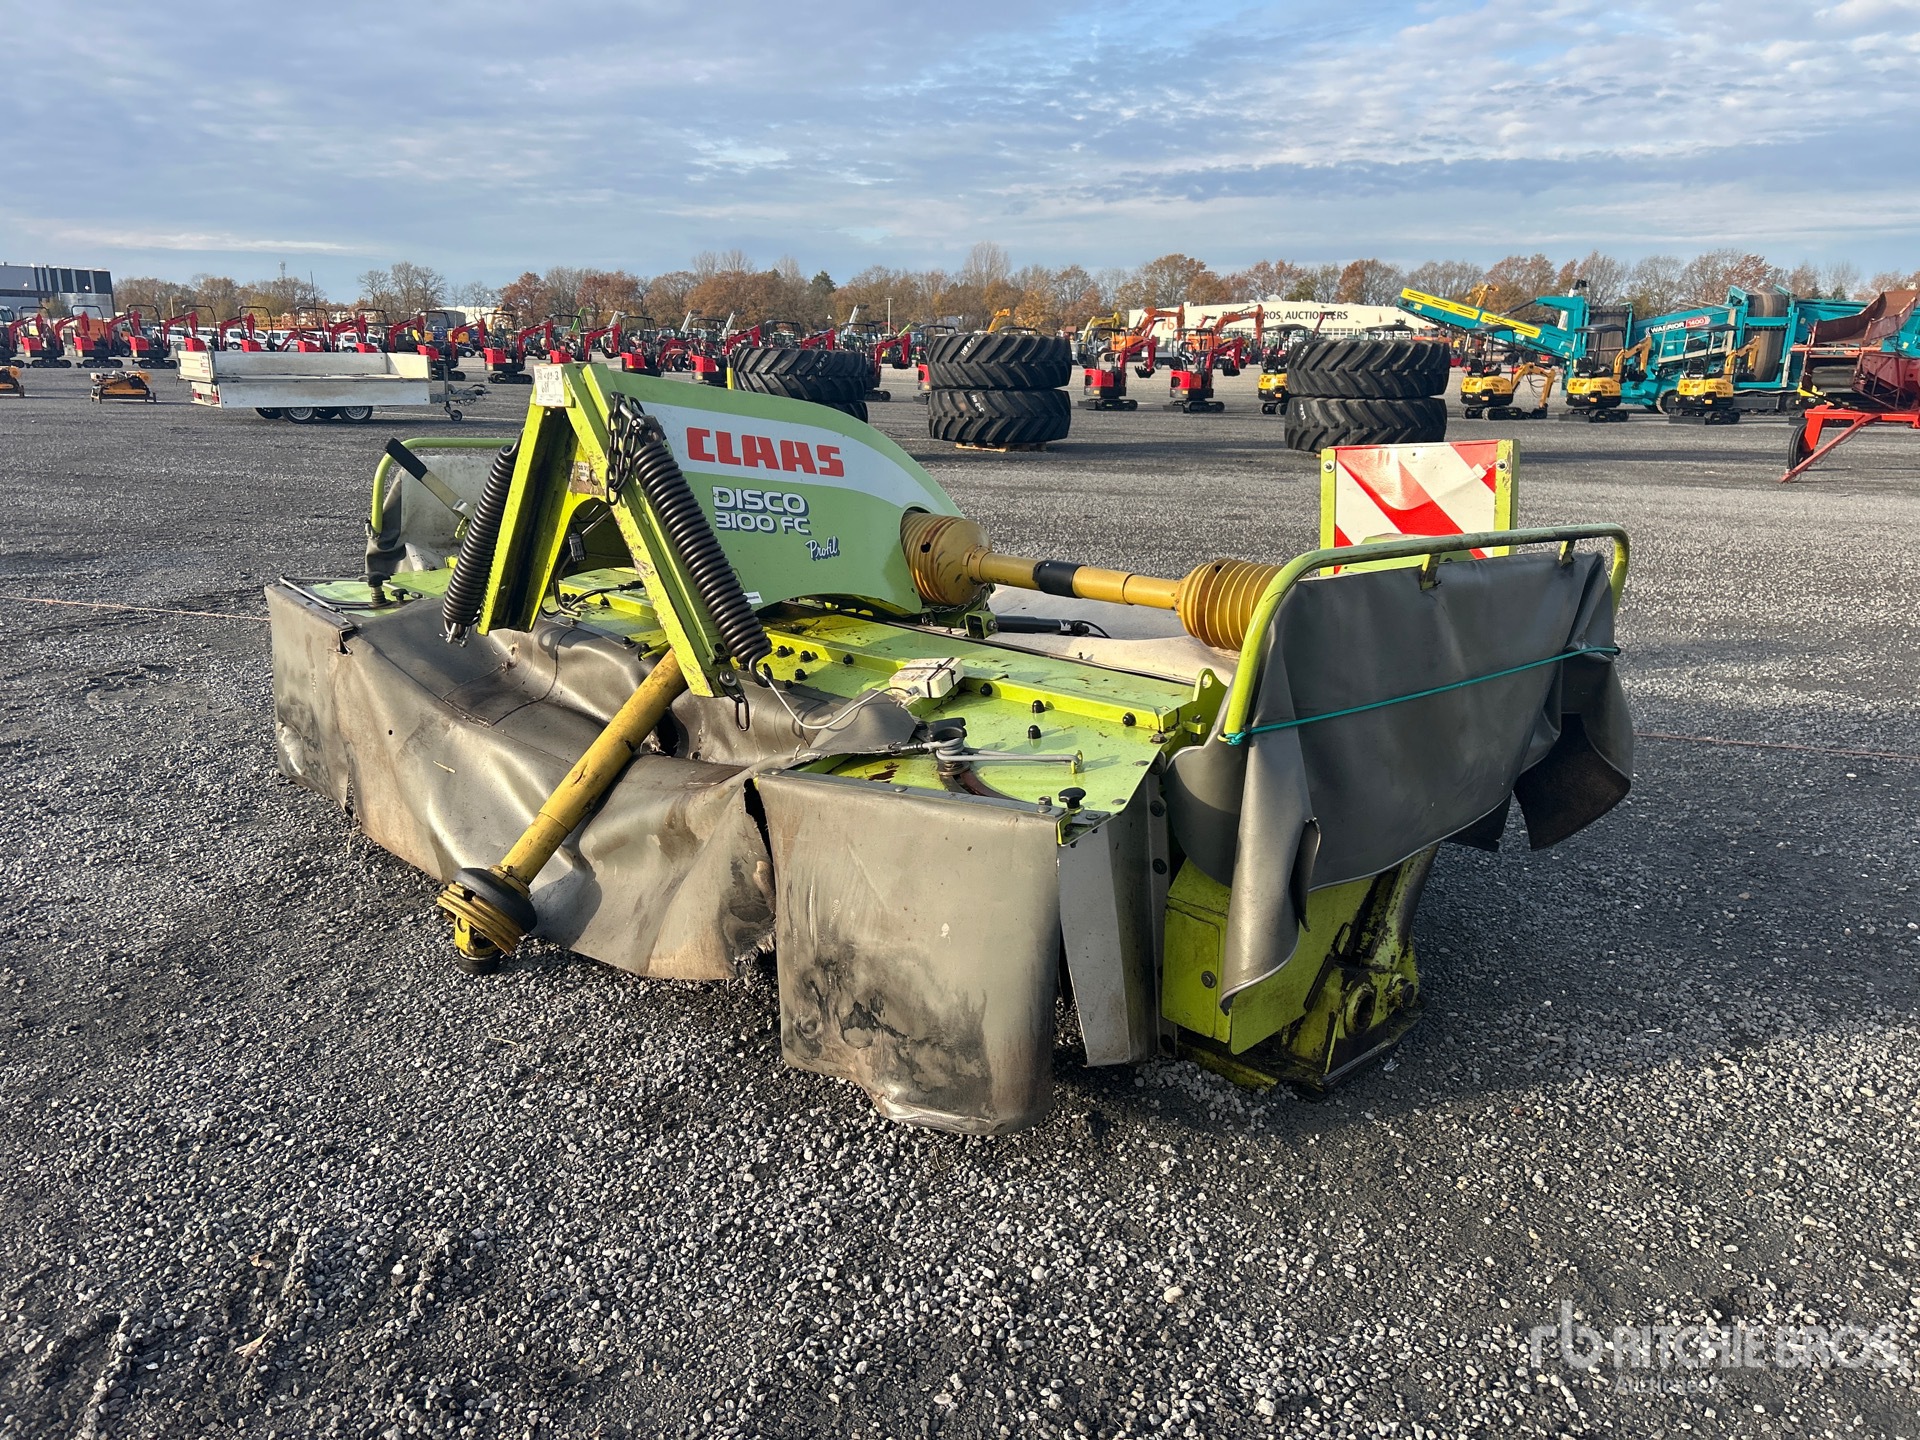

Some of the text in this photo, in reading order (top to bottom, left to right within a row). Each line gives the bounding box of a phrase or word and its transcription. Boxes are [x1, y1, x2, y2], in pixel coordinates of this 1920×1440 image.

[1687, 318, 1705, 327] 1400
[686, 426, 845, 478] CLAAS
[712, 486, 809, 516] DISCO
[714, 511, 812, 536] 3100 FC
[804, 535, 840, 562] Profil
